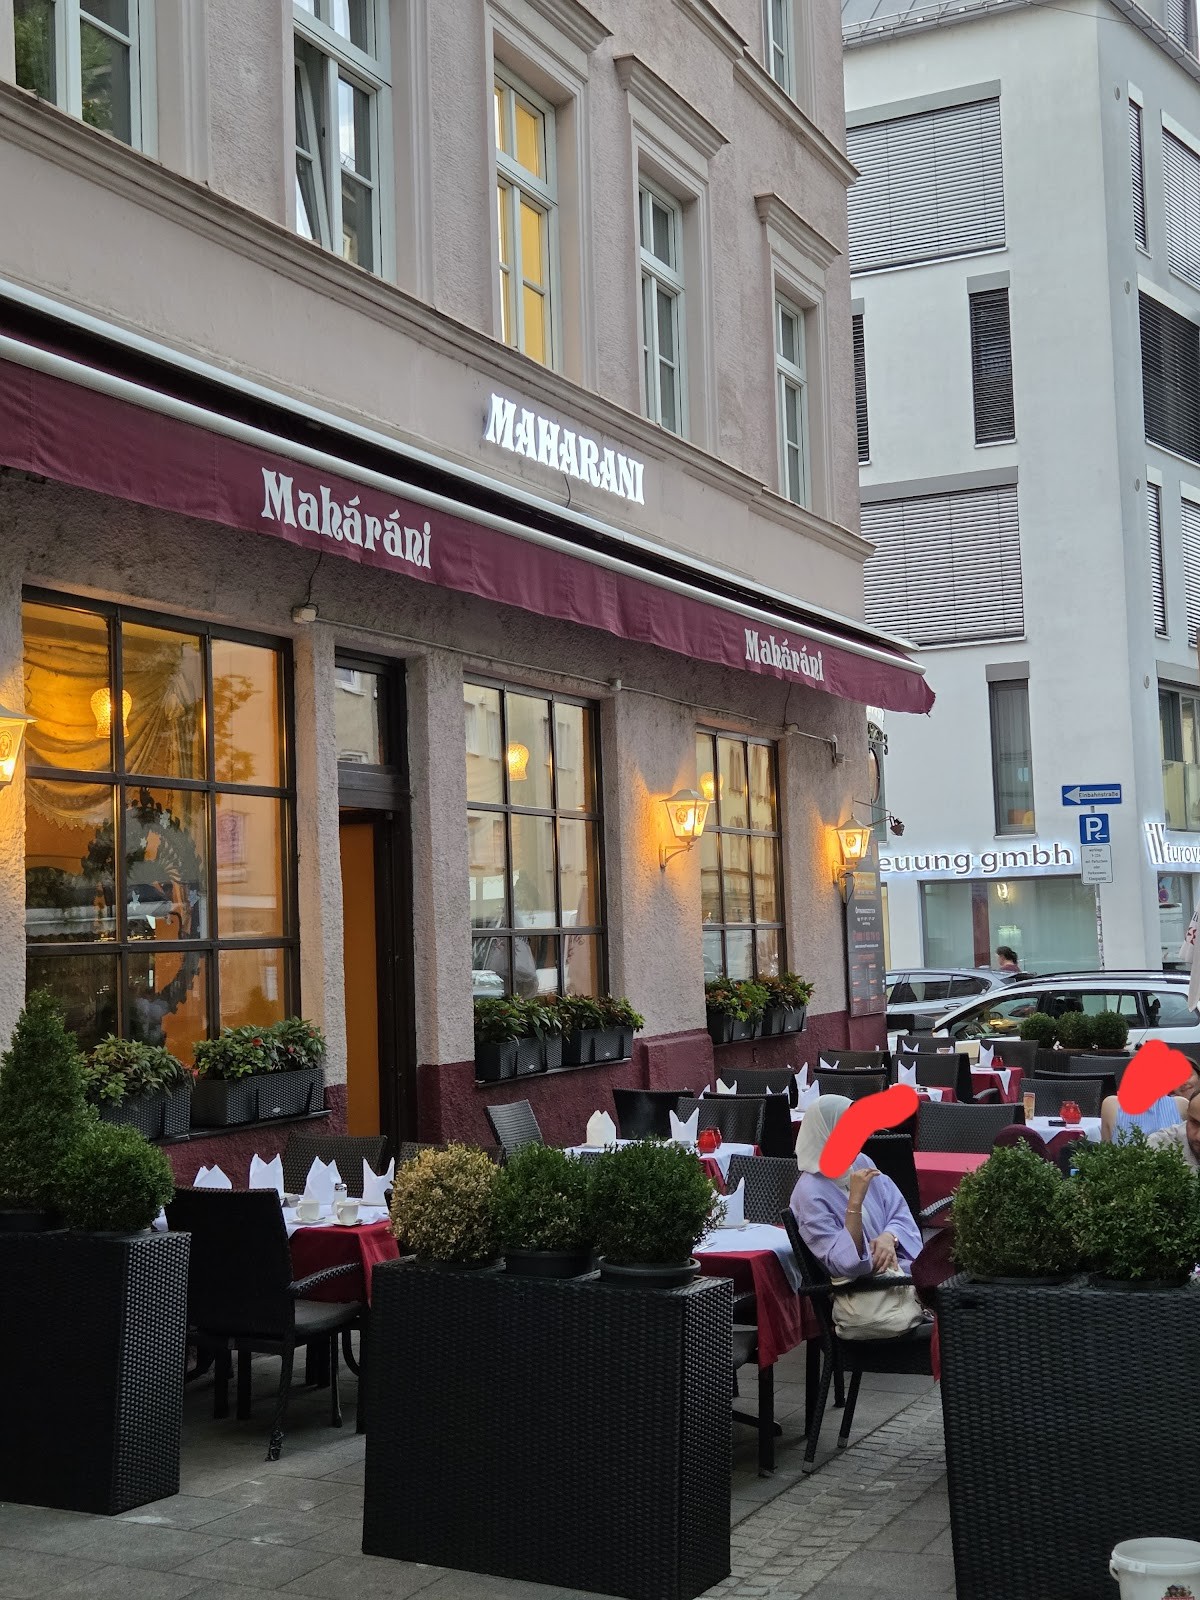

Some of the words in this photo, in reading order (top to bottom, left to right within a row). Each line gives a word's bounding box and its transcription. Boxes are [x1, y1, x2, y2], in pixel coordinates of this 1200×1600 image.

[485, 393, 645, 506] MAHARANI
[1085, 817, 1102, 840] P
[981, 843, 1072, 873] gmbh
